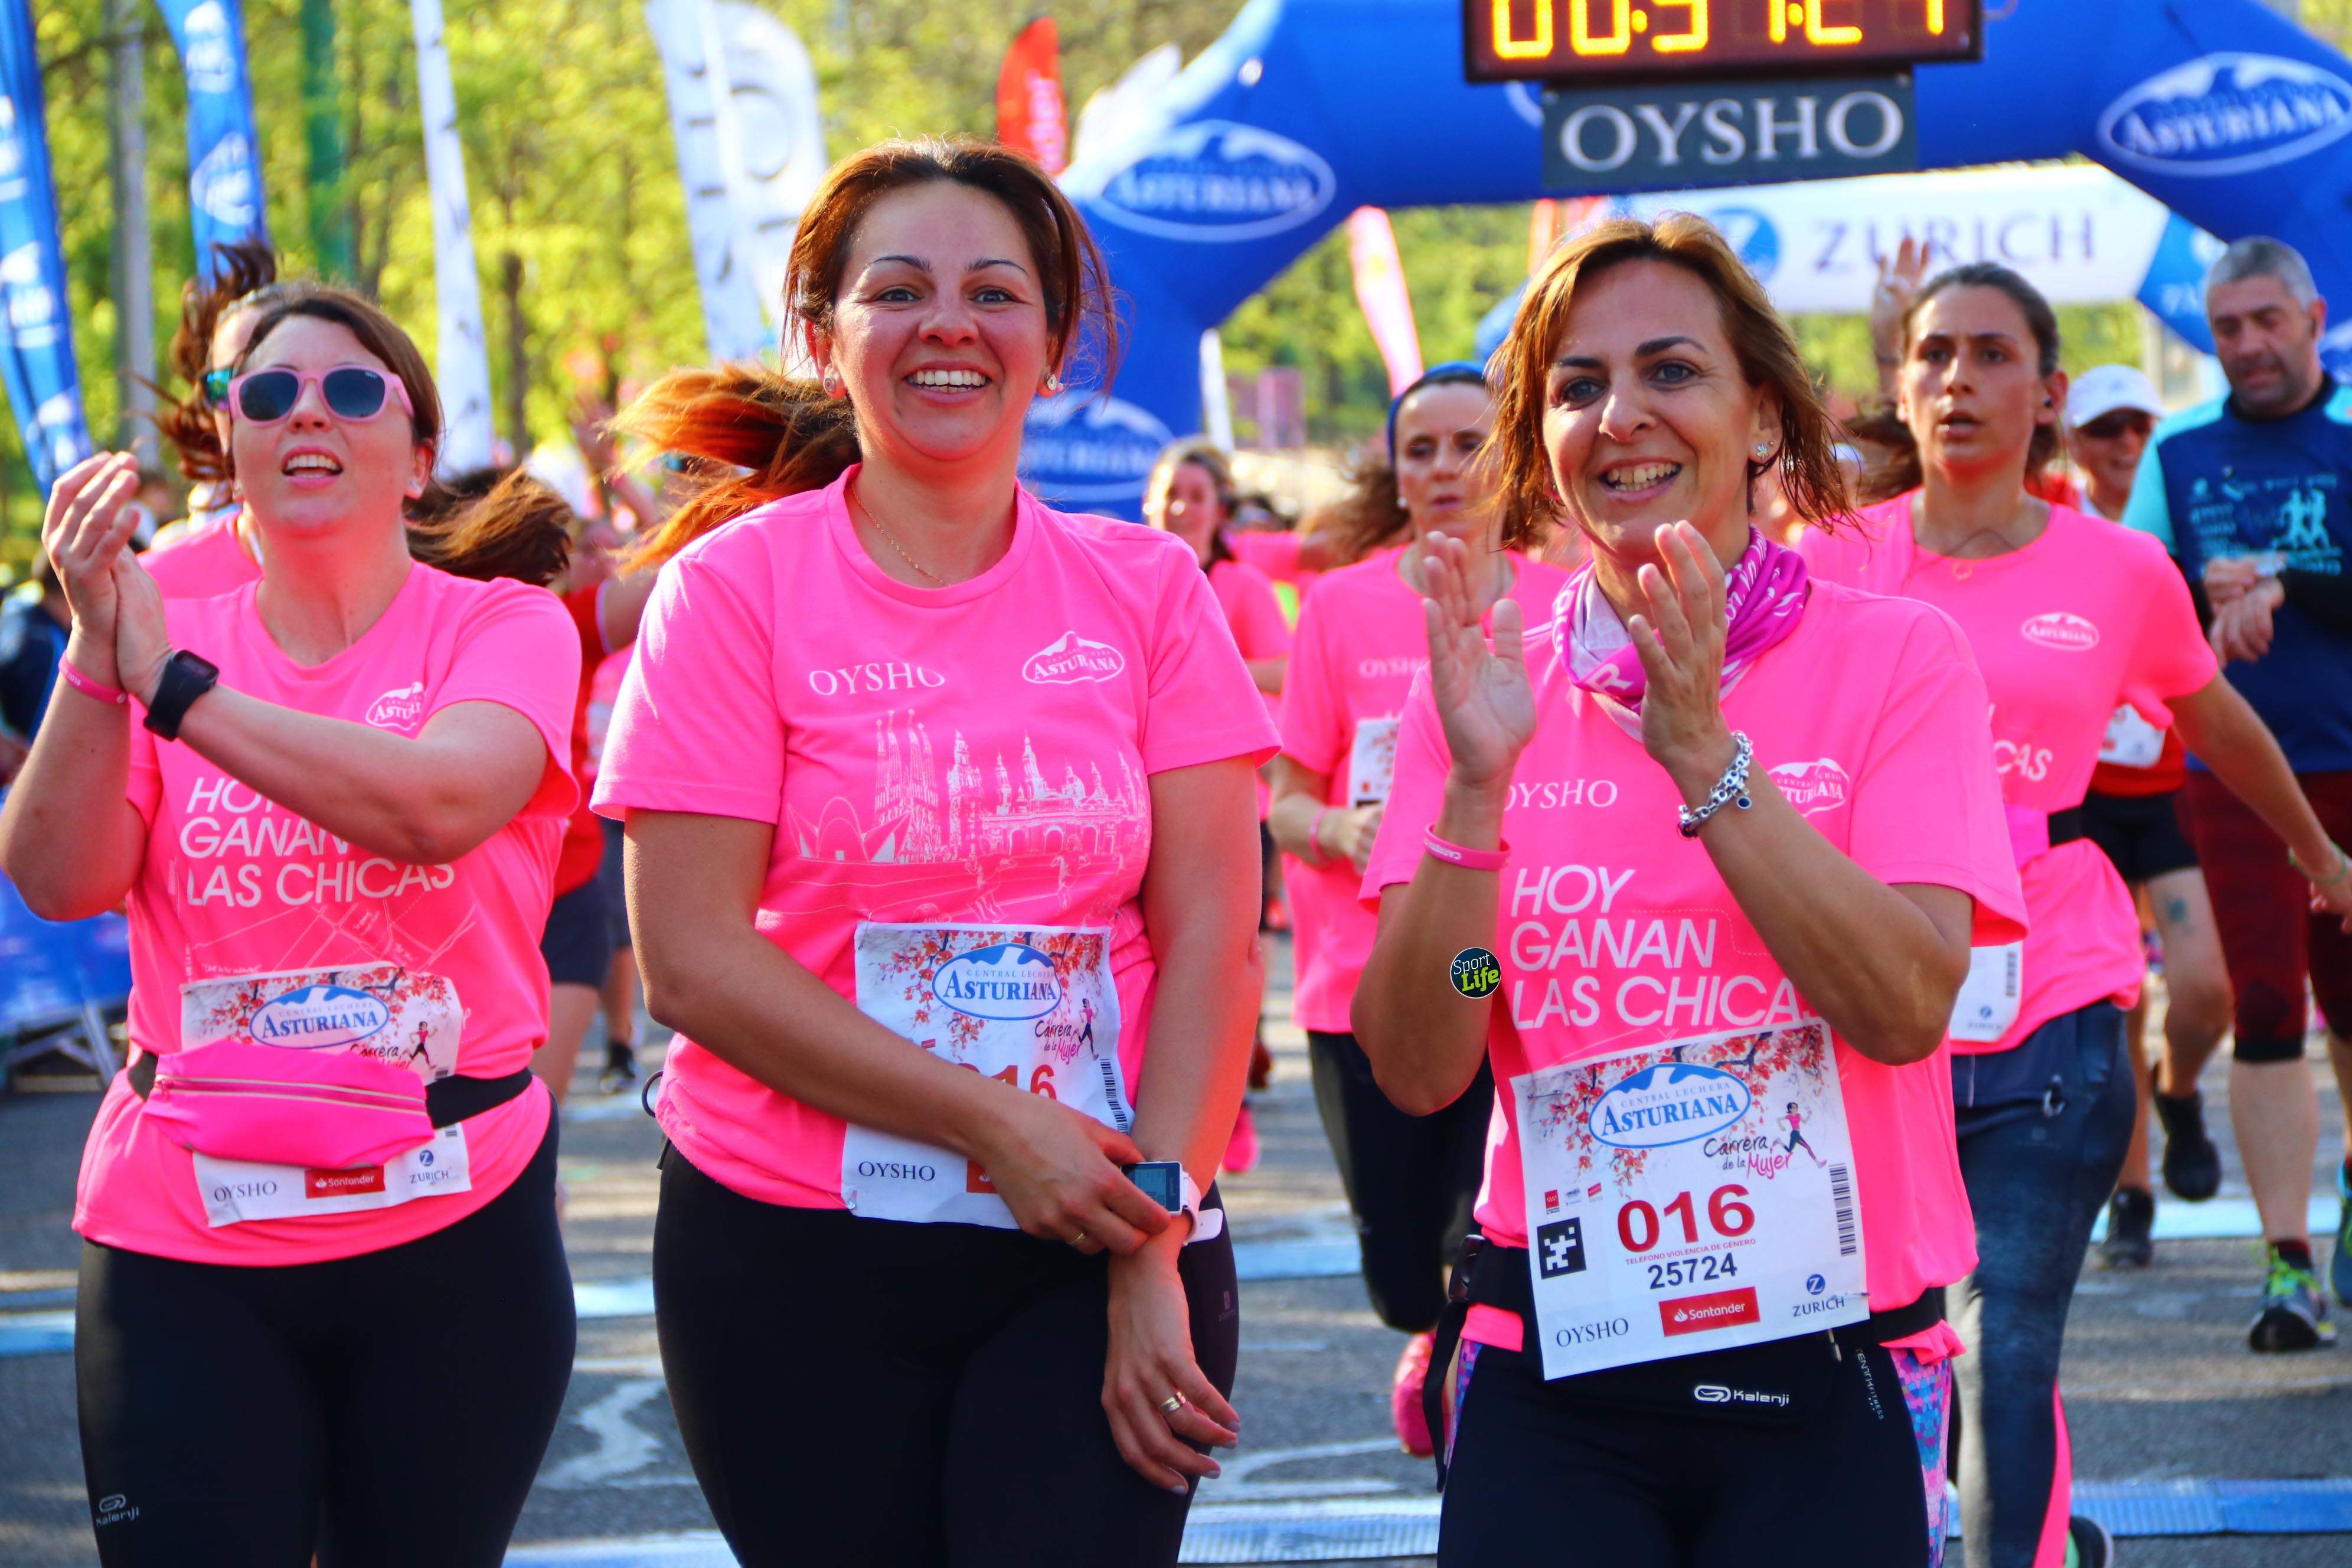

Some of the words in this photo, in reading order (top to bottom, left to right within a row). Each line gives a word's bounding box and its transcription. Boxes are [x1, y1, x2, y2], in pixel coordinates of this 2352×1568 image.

[1560, 90, 1904, 172] OYSHO
[2124, 89, 2348, 156] ASTURIANA
[1810, 211, 2094, 271] ZURICH
[809, 662, 945, 696] OYSHO
[1033, 653, 1119, 680] ASTURANA
[1994, 739, 2053, 782] CAS
[186, 777, 274, 814] HO
[180, 818, 348, 859] GANAN
[187, 865, 262, 907] LAS
[276, 857, 455, 905] CHICAS
[1511, 864, 1636, 918] HOY
[1509, 919, 1717, 972] GANAN
[943, 970, 1057, 1000] ASTURIANA
[966, 969, 1017, 978] CENTRAL
[1512, 976, 1600, 1029] LAS
[1616, 976, 1814, 1027] CHICA
[262, 1011, 378, 1038] ASTURIANA
[1035, 1020, 1072, 1038] Carrera
[1044, 1040, 1050, 1051] de
[1051, 1040, 1057, 1051] la
[1055, 1037, 1084, 1065] Mujer
[1621, 1092, 1670, 1109] CENTRAL
[1675, 1082, 1731, 1098] LECHERA
[1600, 1093, 1740, 1137] ASTURIANA
[1704, 1135, 1769, 1158] Carrera
[1722, 1156, 1734, 1171] de
[1737, 1154, 1746, 1168] la
[1747, 1146, 1793, 1180] Mujer
[214, 1181, 277, 1203] OYSHO
[328, 1174, 375, 1187] Santander
[409, 1170, 449, 1184] ZURICH
[858, 1161, 936, 1182] OYSHO
[1618, 1184, 1755, 1253] 016
[1625, 1252, 1665, 1266] TELÉFONO
[1666, 1245, 1710, 1258] VIOLENCIA
[1723, 1237, 1756, 1249] GÉNERO
[1648, 1252, 1738, 1290] 25724
[1556, 1317, 1629, 1348] OYSHO
[1688, 1302, 1746, 1321] Santander
[1792, 1296, 1845, 1317] ZURICH
[1733, 1389, 1790, 1407] Kalenji
